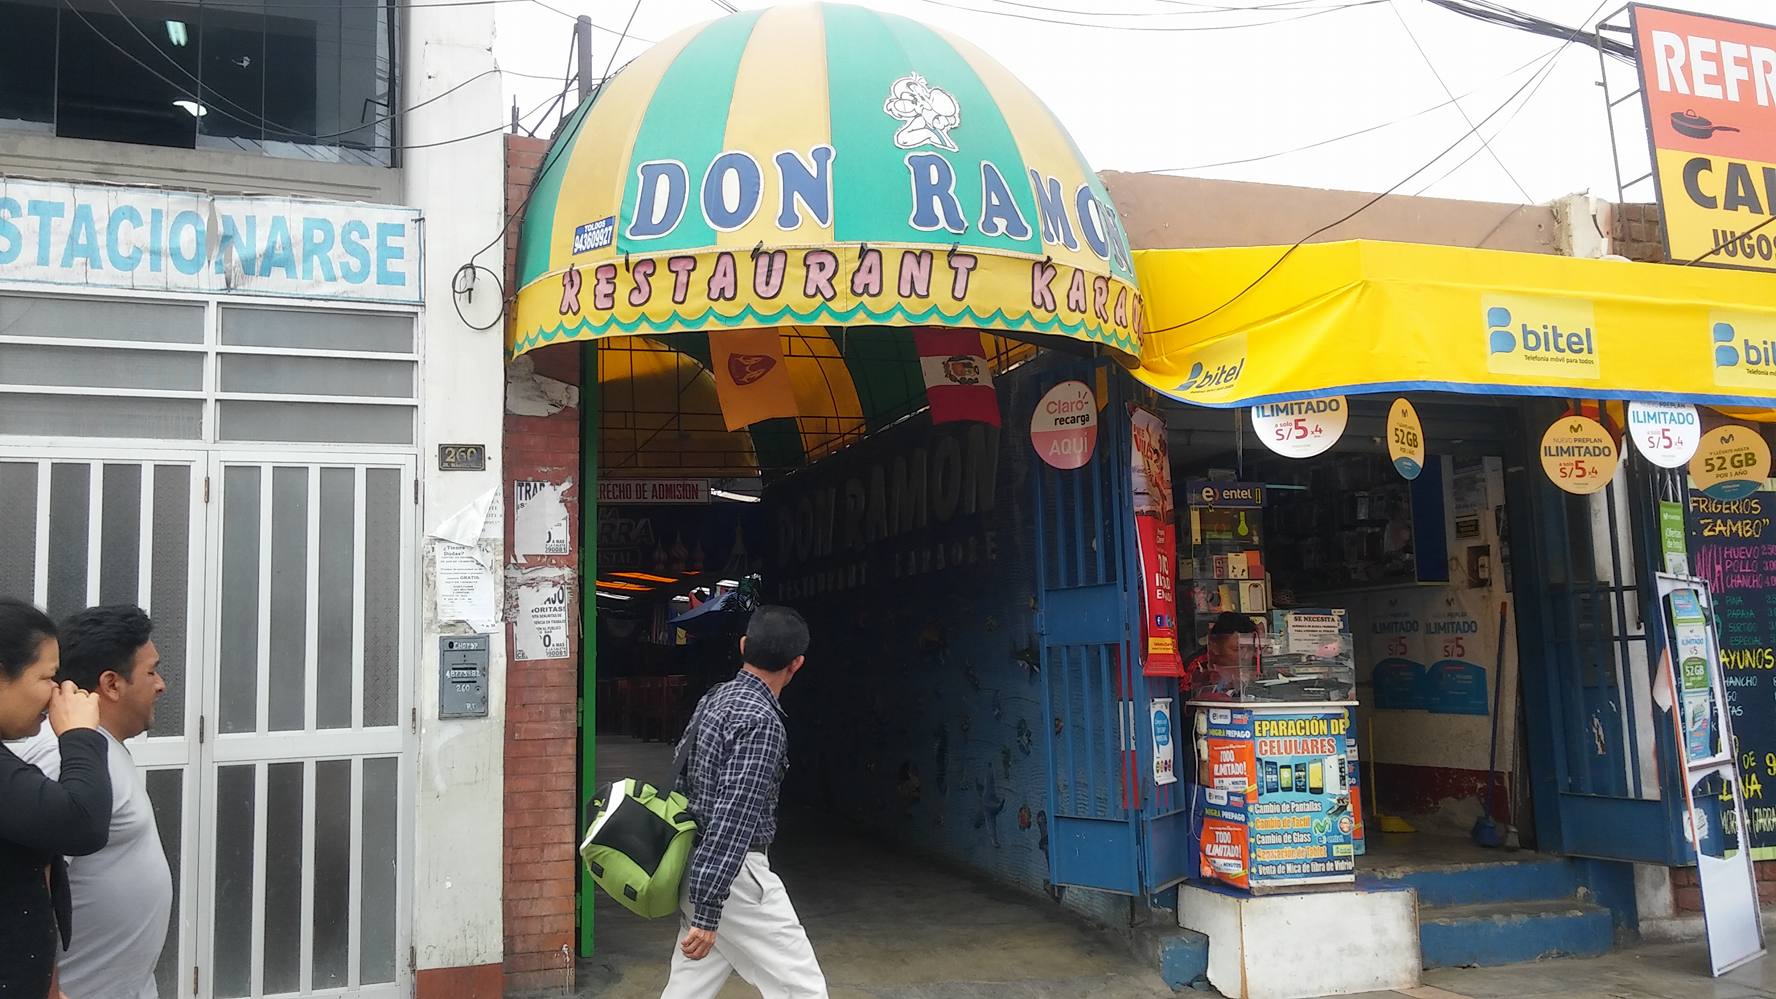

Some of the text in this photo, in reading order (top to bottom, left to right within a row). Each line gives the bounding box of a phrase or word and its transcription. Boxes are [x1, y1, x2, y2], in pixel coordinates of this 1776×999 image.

[625, 144, 1133, 276] DON RAMON
[584, 220, 606, 232] TOLDOS
[0, 196, 407, 287] STACIONARSE
[559, 248, 978, 316] RESTAURANT
[1522, 323, 1594, 355] bitel
[1196, 358, 1244, 388] bitel
[1046, 399, 1084, 415] Claro
[1255, 398, 1340, 418] ILIMITADO
[1054, 413, 1090, 426] recarga
[1632, 410, 1695, 425] ILIMITADO
[1544, 446, 1612, 457] ILIMITADO
[1704, 452, 1757, 472] 52 GB
[1735, 469, 1748, 477] AÑO
[635, 483, 648, 500] DE
[1223, 488, 1252, 500] entel
[1724, 546, 1759, 559] HUEVO
[1425, 621, 1477, 634] ILIMITADO
[1720, 648, 1774, 669] AYUNOS
[1225, 729, 1251, 738] PREPAGO
[1254, 717, 1330, 736] EPARACIÓN
[1331, 718, 1346, 735] DE
[1258, 737, 1336, 755] CELULARES
[1255, 801, 1321, 813] Cambio de Pantallas
[1222, 811, 1245, 822] PREPAGO
[1255, 818, 1281, 830] Cambio
[1282, 818, 1292, 828] de
[1215, 831, 1231, 843] TODO
[1256, 833, 1282, 844] Cambio
[1283, 833, 1292, 843] de
[1293, 832, 1311, 843] Glass
[1259, 864, 1275, 875] Venta
[1277, 864, 1285, 874] de
[1287, 863, 1301, 873] Mica
[1302, 862, 1310, 872] de
[1326, 861, 1334, 871] de
